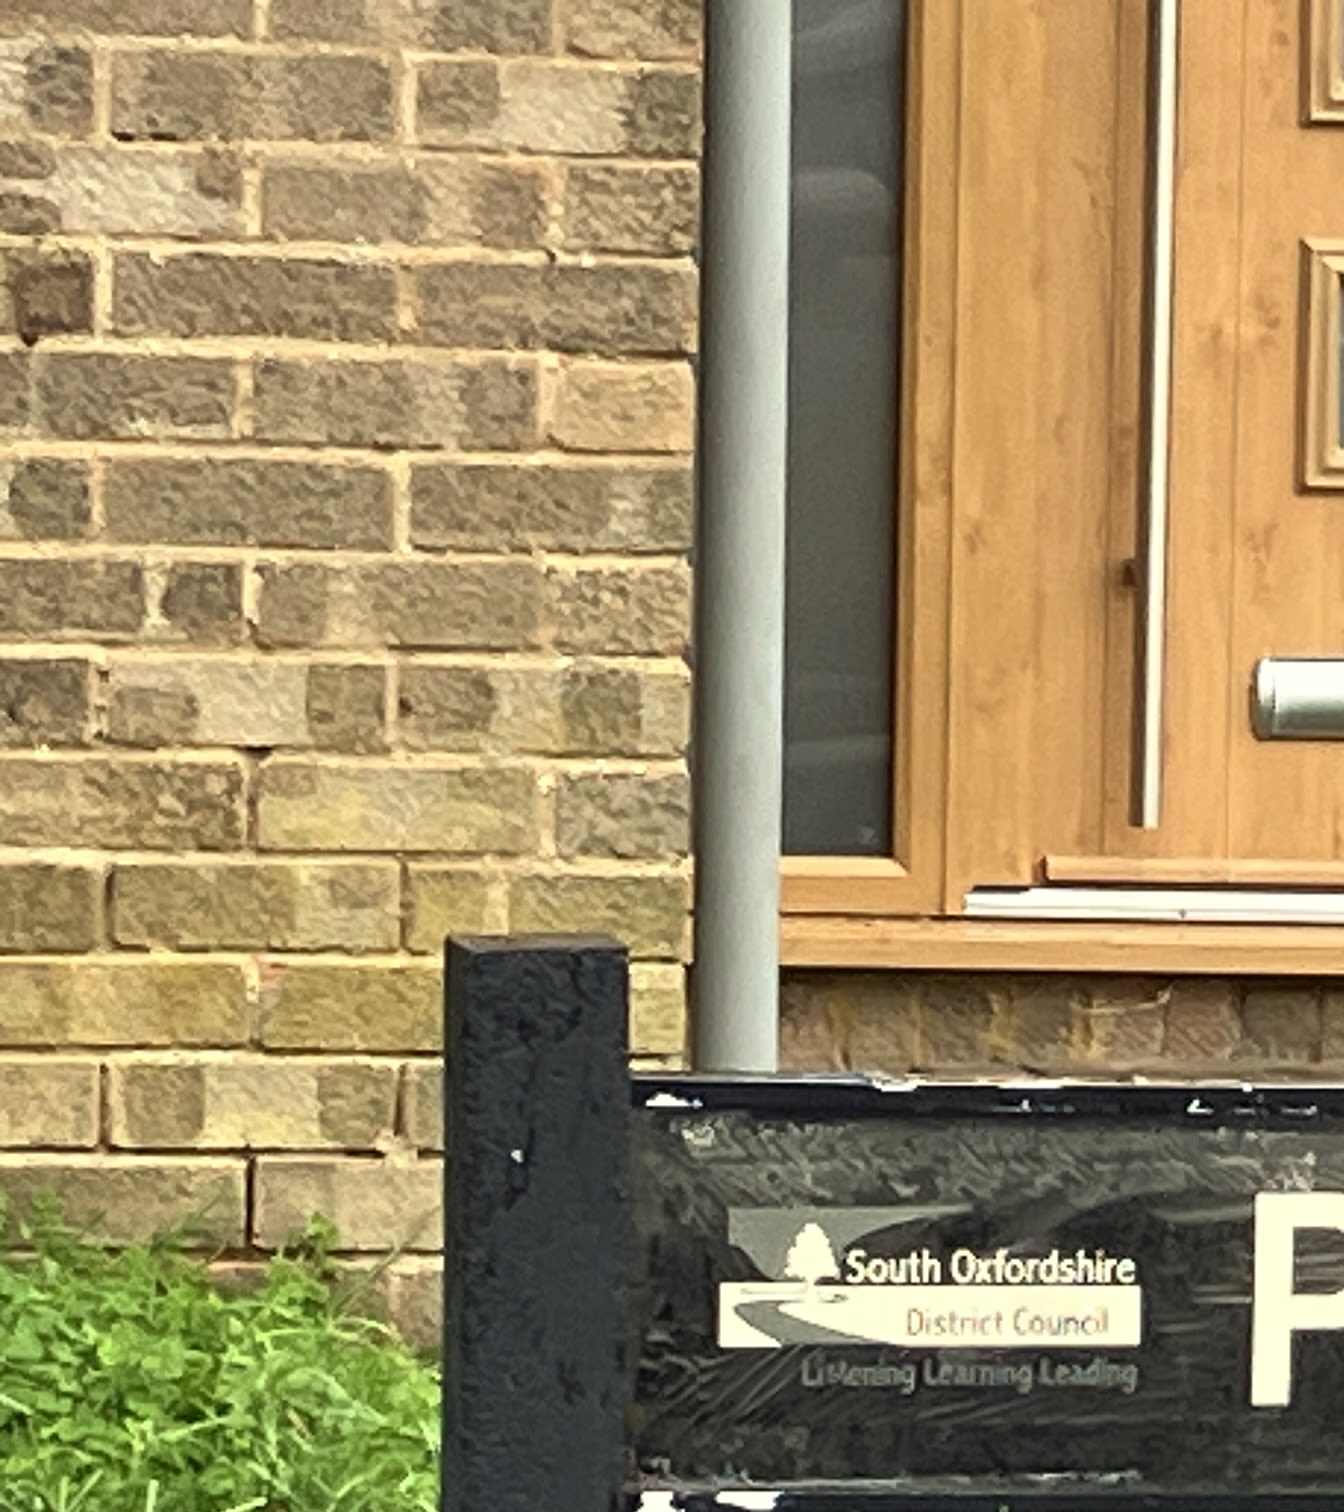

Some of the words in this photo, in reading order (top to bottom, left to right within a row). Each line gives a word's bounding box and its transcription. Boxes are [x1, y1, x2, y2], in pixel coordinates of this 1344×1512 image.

[844, 1248, 942, 1285] South
[950, 1248, 1137, 1285] Oxfordshire
[905, 1307, 1003, 1338] District
[1011, 1307, 1110, 1338] Council
[800, 1354, 918, 1395] Listening
[922, 1356, 1033, 1395] Learning
[1038, 1356, 1139, 1394] Leading
